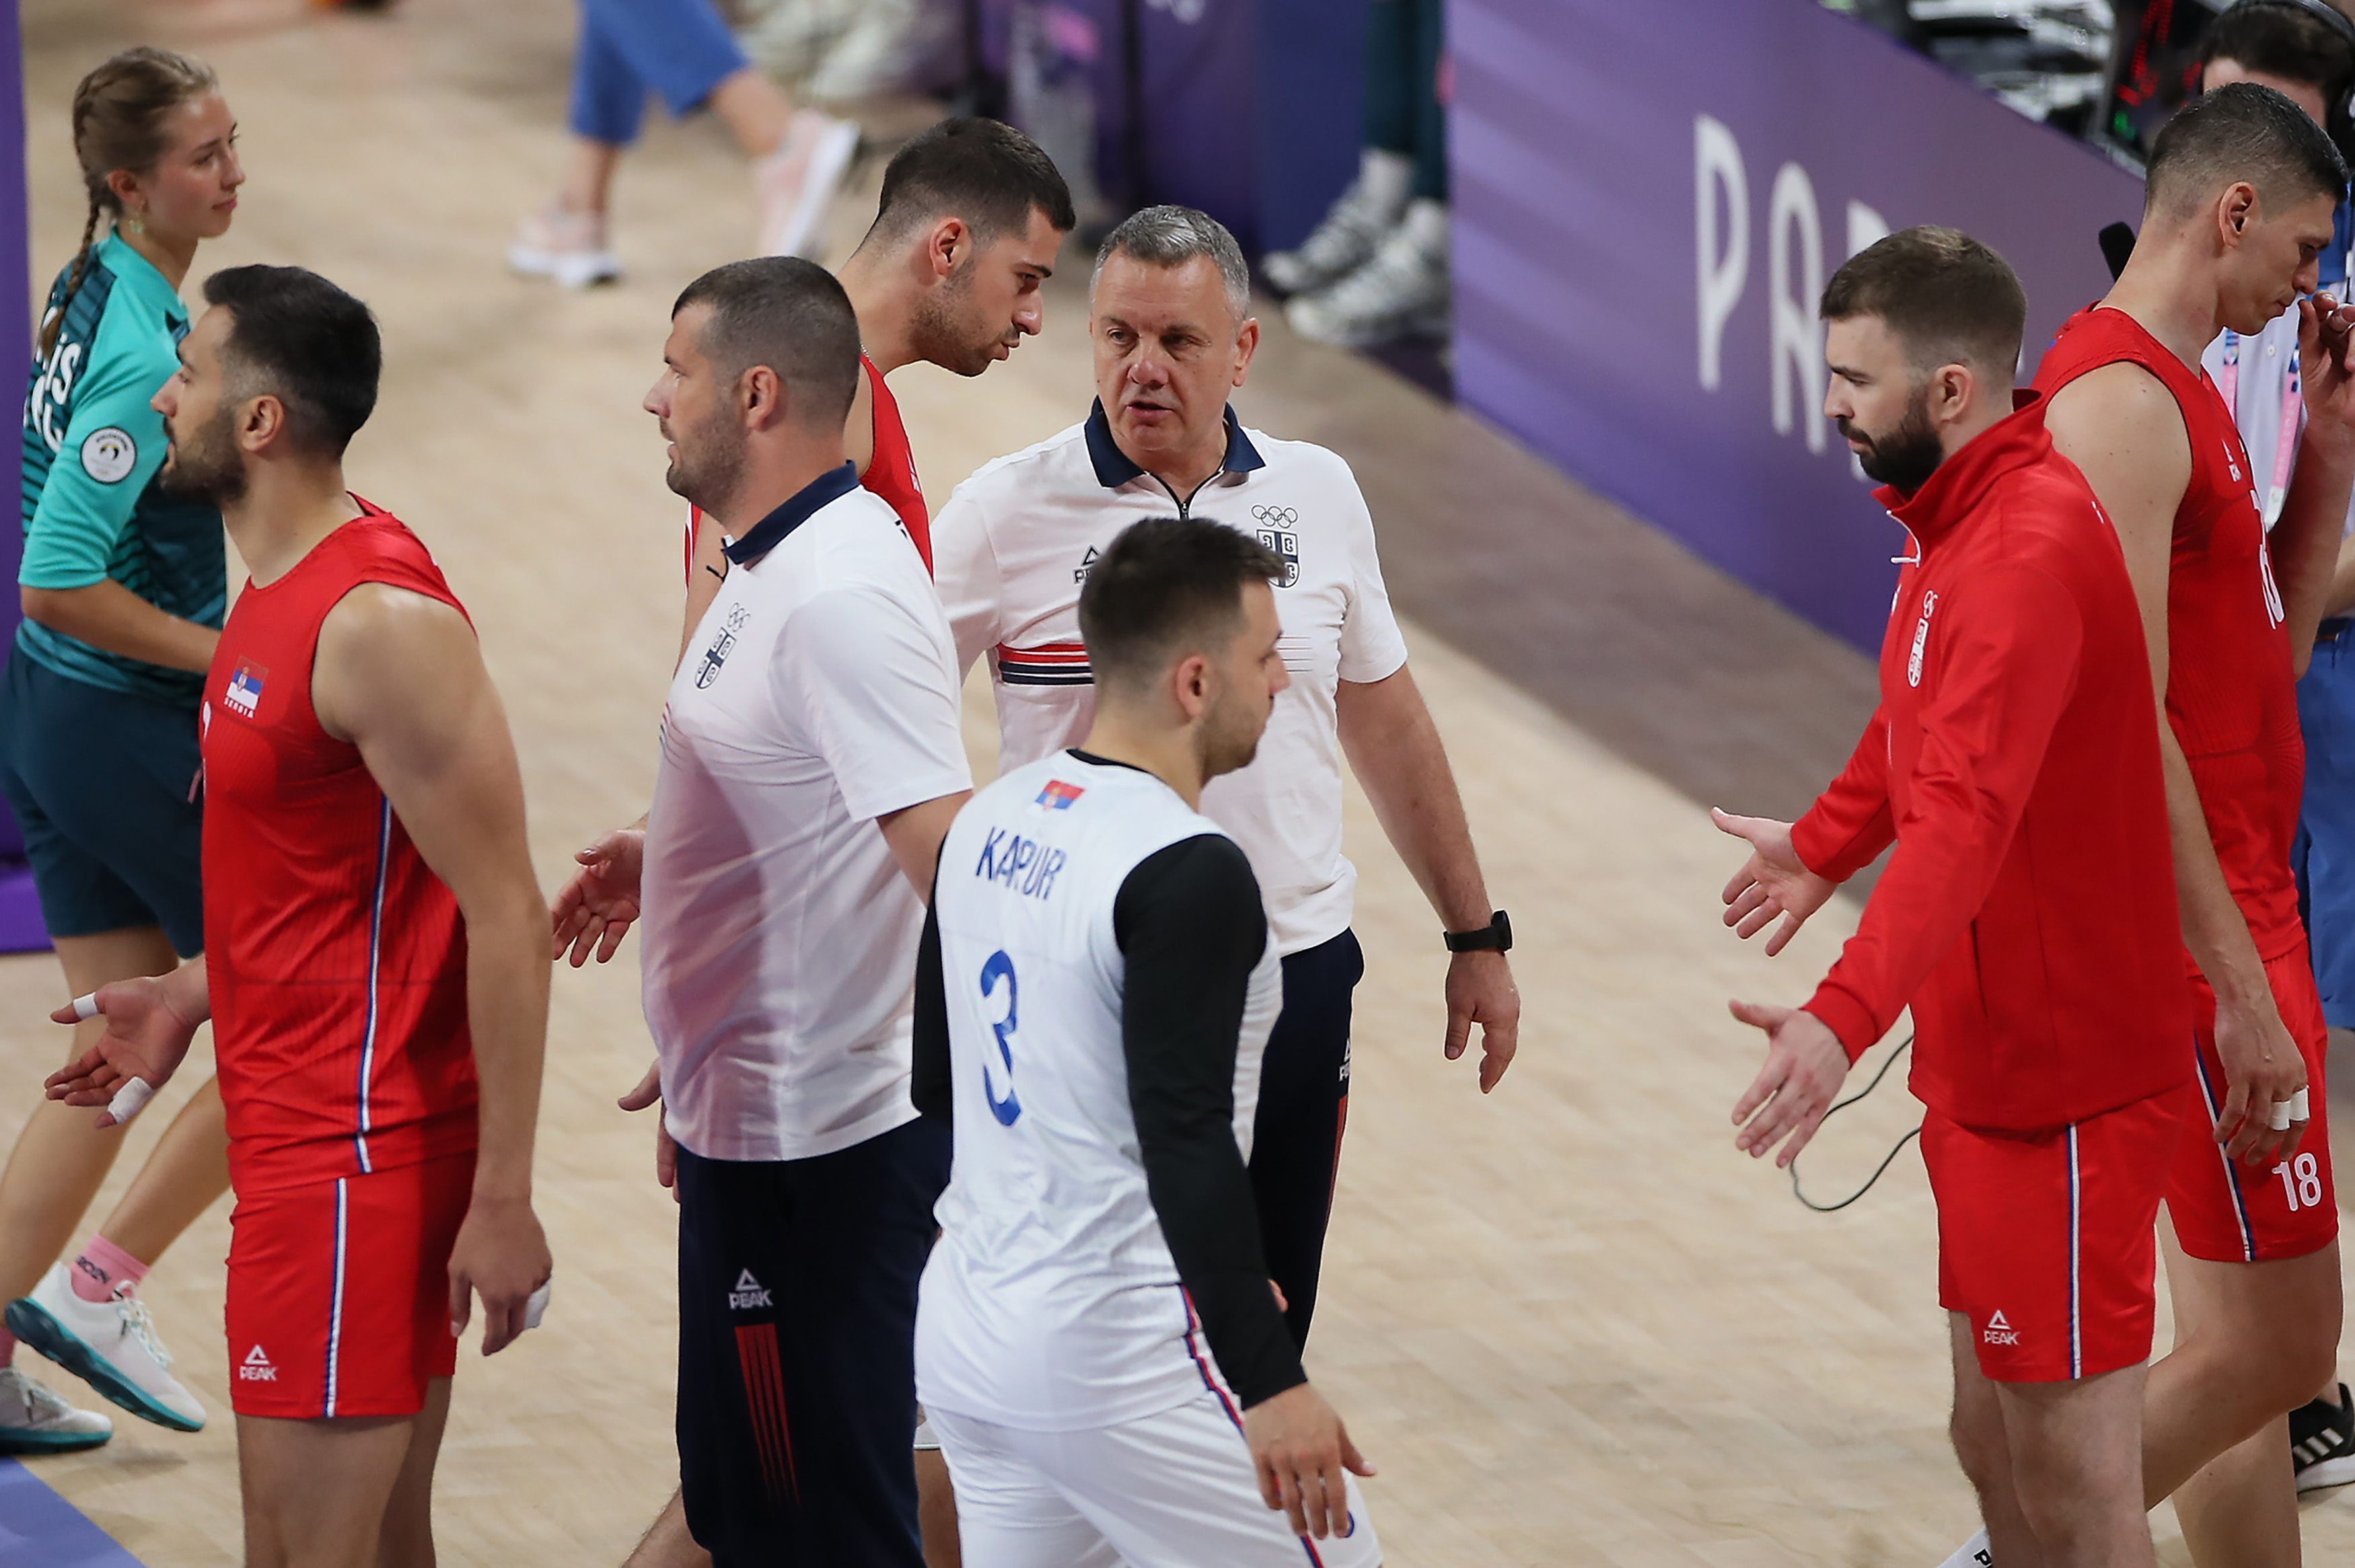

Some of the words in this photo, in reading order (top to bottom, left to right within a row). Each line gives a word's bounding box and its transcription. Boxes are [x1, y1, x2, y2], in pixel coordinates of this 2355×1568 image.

[223, 696, 255, 718] SERBIA
[976, 826, 1067, 901] KAPUR
[980, 948, 1022, 1127] 3
[2272, 1152, 2321, 1211] 18
[728, 1289, 774, 1310] PEAK
[1984, 1330, 2021, 1346] PEAK
[239, 1366, 279, 1381] PEAK
